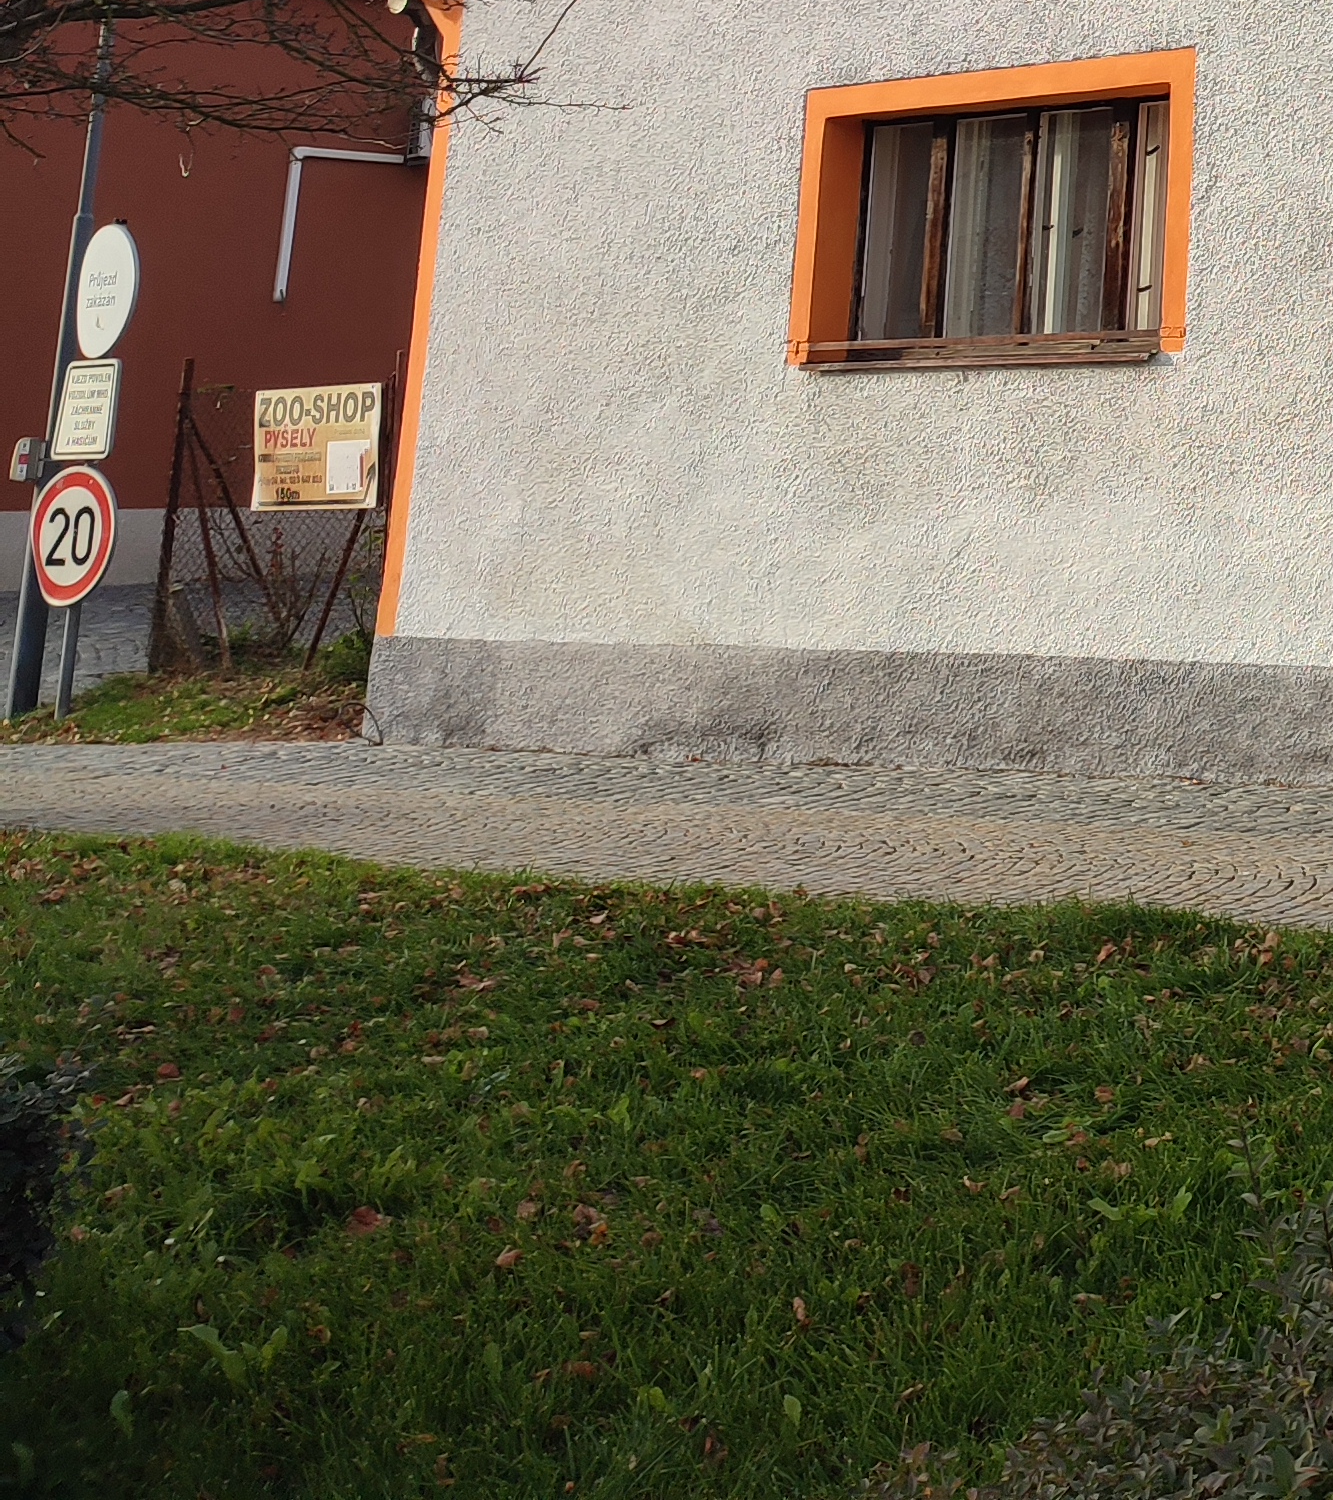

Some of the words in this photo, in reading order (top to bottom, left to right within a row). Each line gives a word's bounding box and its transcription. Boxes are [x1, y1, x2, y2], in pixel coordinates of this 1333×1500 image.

[259, 391, 376, 428] ZOO-SHOP
[264, 424, 317, 449] PYŠELY
[45, 506, 96, 567] 20
